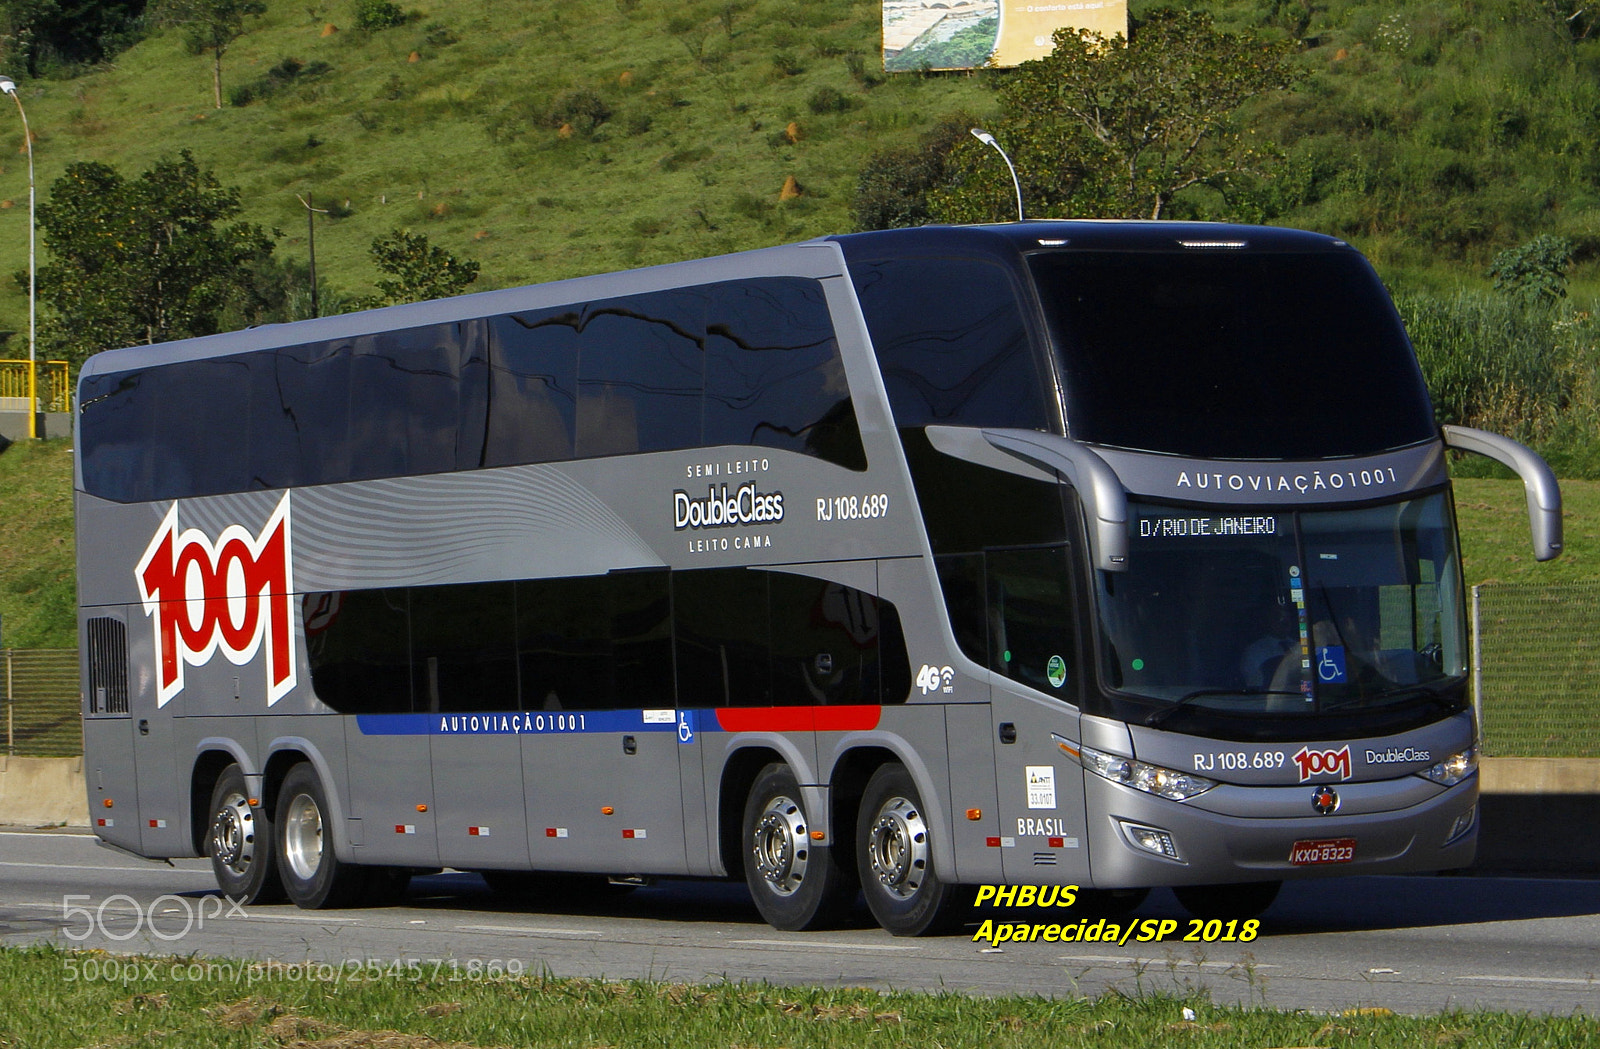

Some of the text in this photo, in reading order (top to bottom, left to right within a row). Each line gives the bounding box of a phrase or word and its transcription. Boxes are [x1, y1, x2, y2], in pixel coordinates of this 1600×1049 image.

[686, 458, 770, 478] SEMI LEITO
[673, 481, 784, 530] DoubleClass
[816, 493, 889, 521] RJ 108.689
[1140, 516, 1275, 537] D/RIO DE JANEIRO
[689, 535, 772, 553] LEITO CAMA
[134, 487, 298, 709] 1001
[916, 664, 941, 695] 4G
[1193, 752, 1285, 771] RJ 108.689
[1291, 744, 1352, 783] 1001
[1365, 748, 1430, 765] DoubleClass
[1017, 818, 1067, 836] BRASIL
